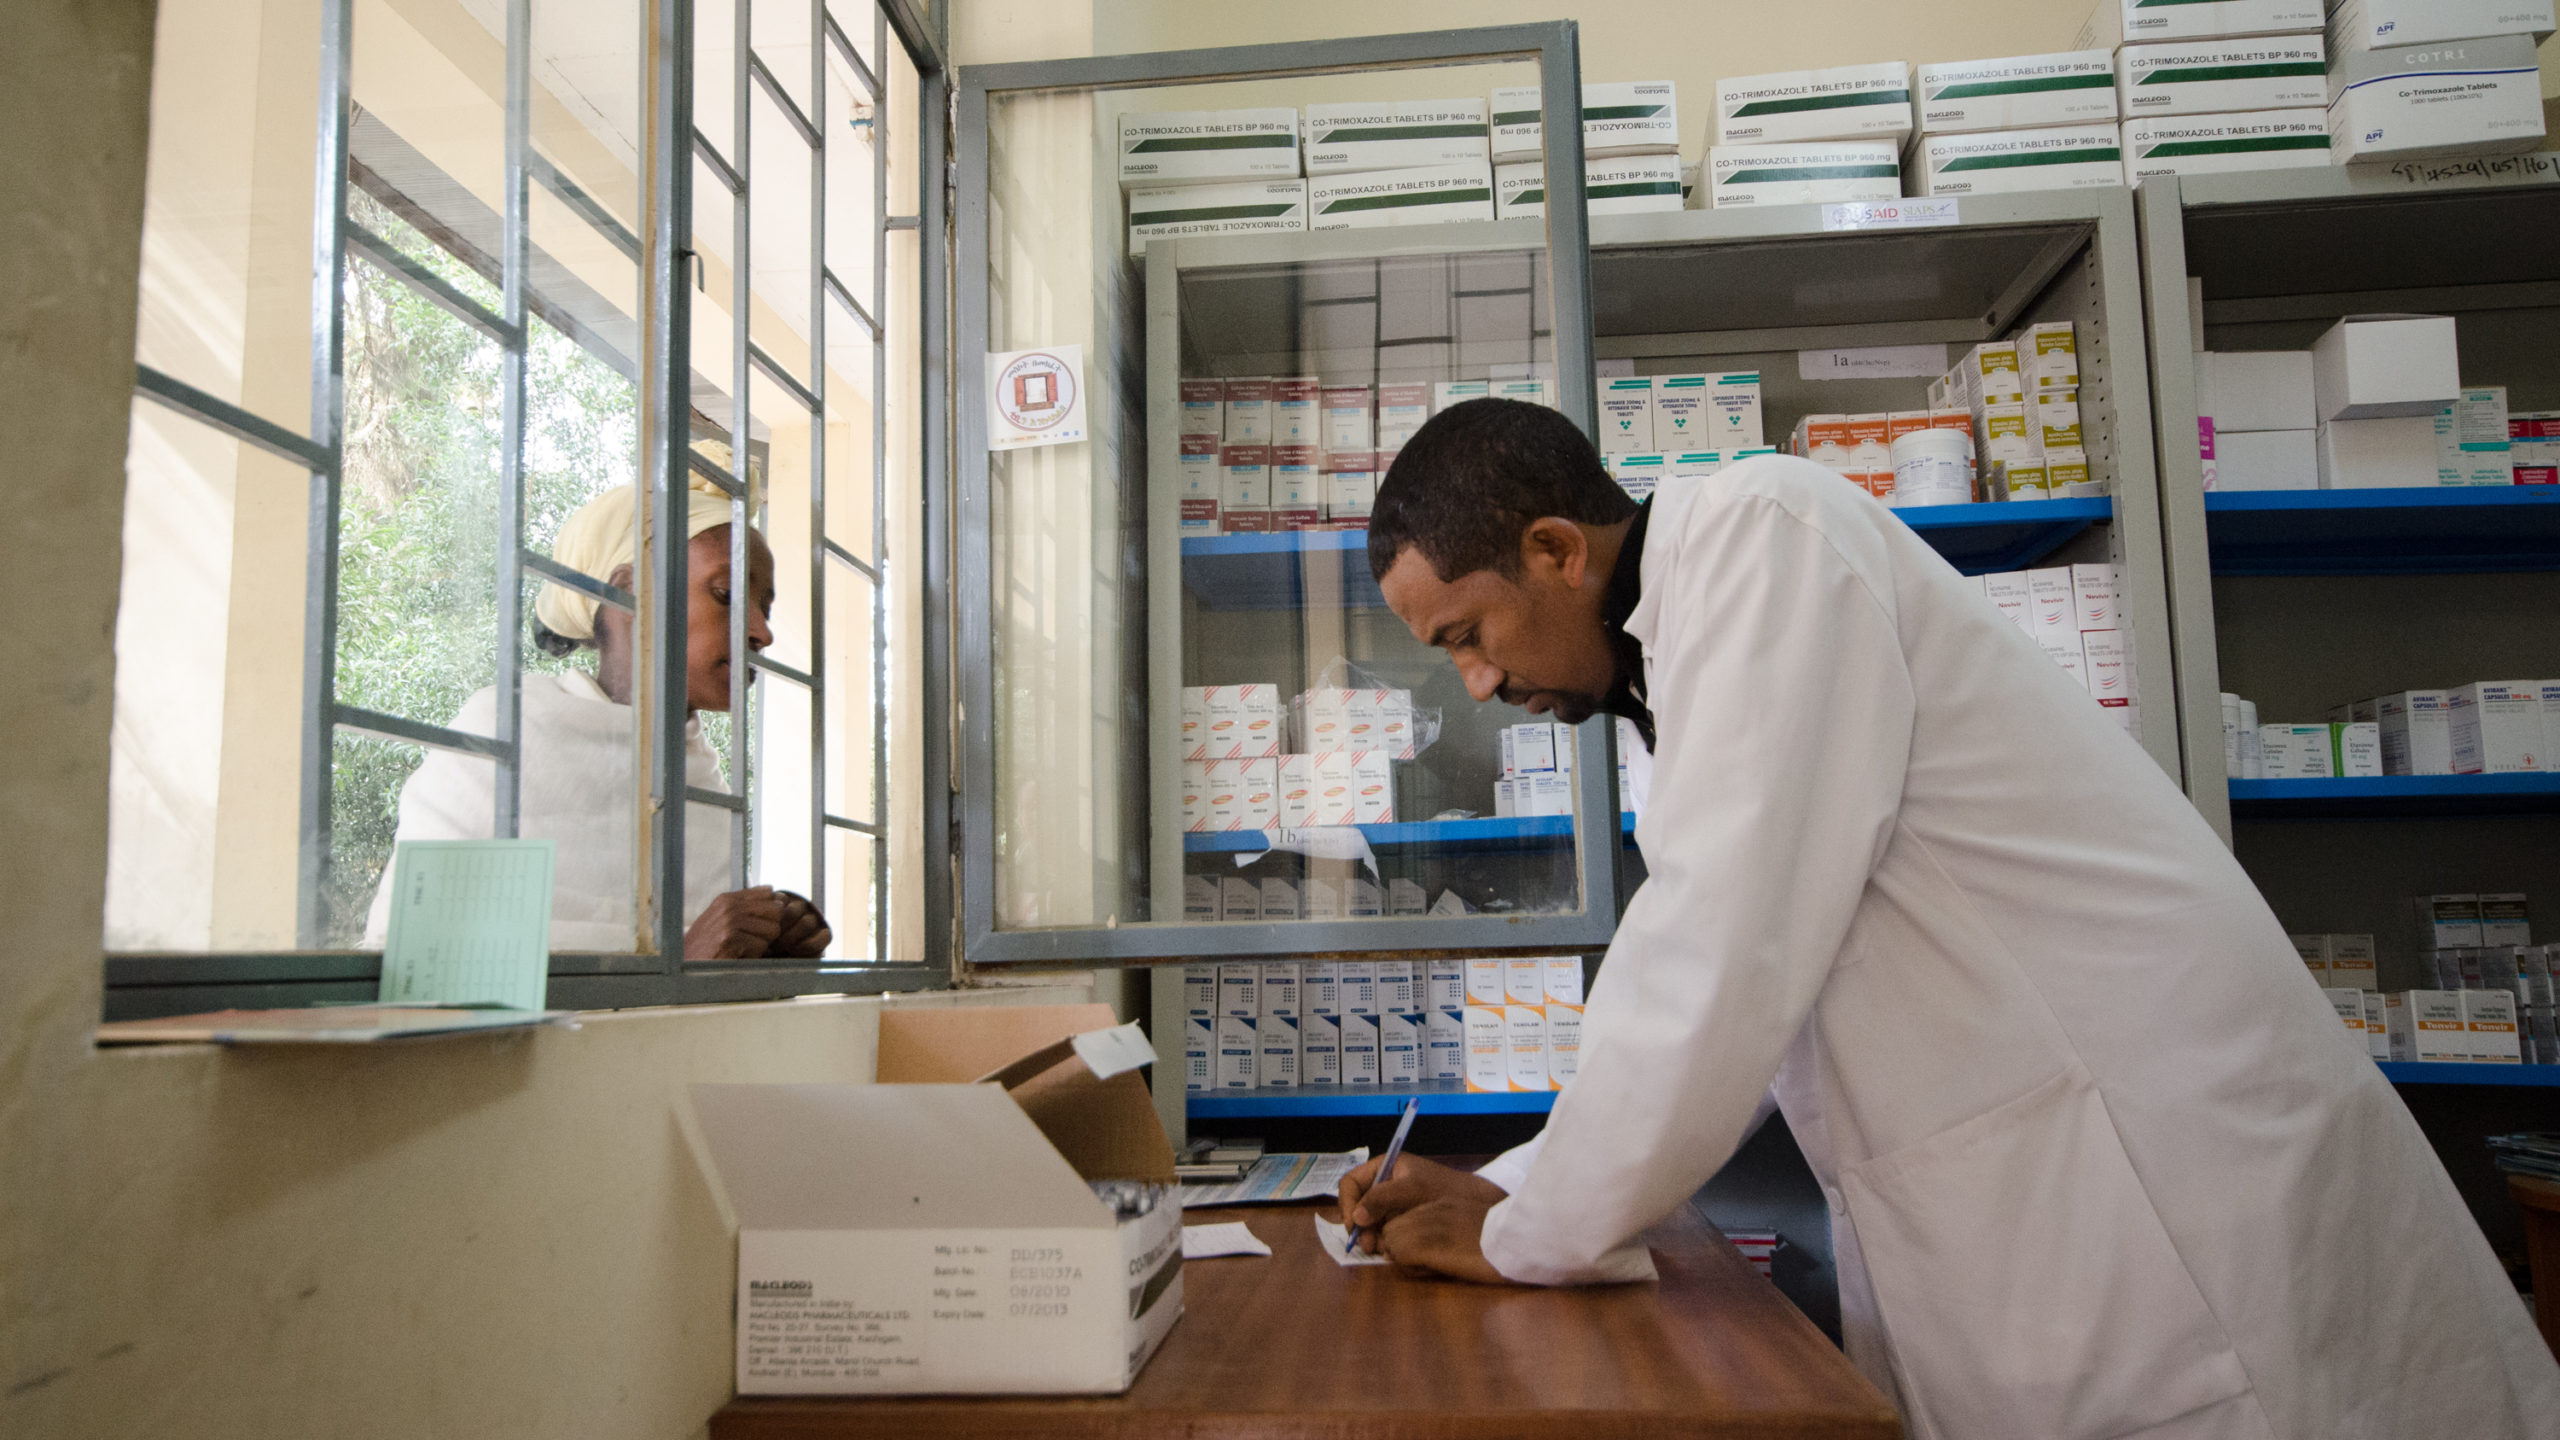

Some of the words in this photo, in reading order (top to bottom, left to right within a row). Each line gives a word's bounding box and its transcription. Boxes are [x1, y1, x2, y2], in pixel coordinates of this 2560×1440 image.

[2377, 23, 2395, 34] APF
[2130, 55, 2219, 67] CO-TRIMOXAZOLE
[2223, 53, 2265, 62] TABLETS
[2303, 51, 2317, 59] mg
[2406, 50, 2465, 64] COTRI
[1925, 70, 2009, 83] CO-TRIMOXAZOLE
[2013, 66, 2055, 75] TABLETS
[2073, 63, 2089, 71] 960
[2092, 63, 2106, 71] mg
[1724, 86, 1808, 101] CO-TRIMOXAZOLE
[1811, 82, 1852, 92] TABLETS
[1855, 80, 1867, 88] BP
[1870, 79, 1886, 87] 960
[1889, 79, 1902, 87] mg
[2399, 85, 2464, 98] Co-Trimoxazole
[1313, 116, 1392, 127] CO-TRIMOXAZOLE
[1395, 114, 1434, 123] TABLETS
[1125, 125, 1200, 136] CO-TRIMOXAZOLE
[1205, 124, 1243, 133] TABLETS
[1246, 123, 1257, 131] BP
[2135, 128, 2223, 140] CO-TRIMOXAZOLE
[2227, 126, 2270, 134] TABLETS
[2309, 124, 2323, 132] mg
[2366, 129, 2383, 142] APF
[1932, 143, 2016, 156] CO-TRIMOXAZOLE
[2020, 139, 2062, 149] TABLETS
[2065, 138, 2077, 146] BP
[2080, 137, 2095, 145] 960
[1660, 171, 1674, 179] mg
[1314, 185, 1393, 198] CO-TRIMOXAZOLE
[1395, 181, 1436, 192] TABLETS
[1438, 179, 1450, 187] BP
[1453, 178, 1467, 186] 960
[1470, 178, 1483, 186] mg
[2425, 1022, 2457, 1030] Tenvir
[2475, 1023, 2508, 1031] Tenvir
